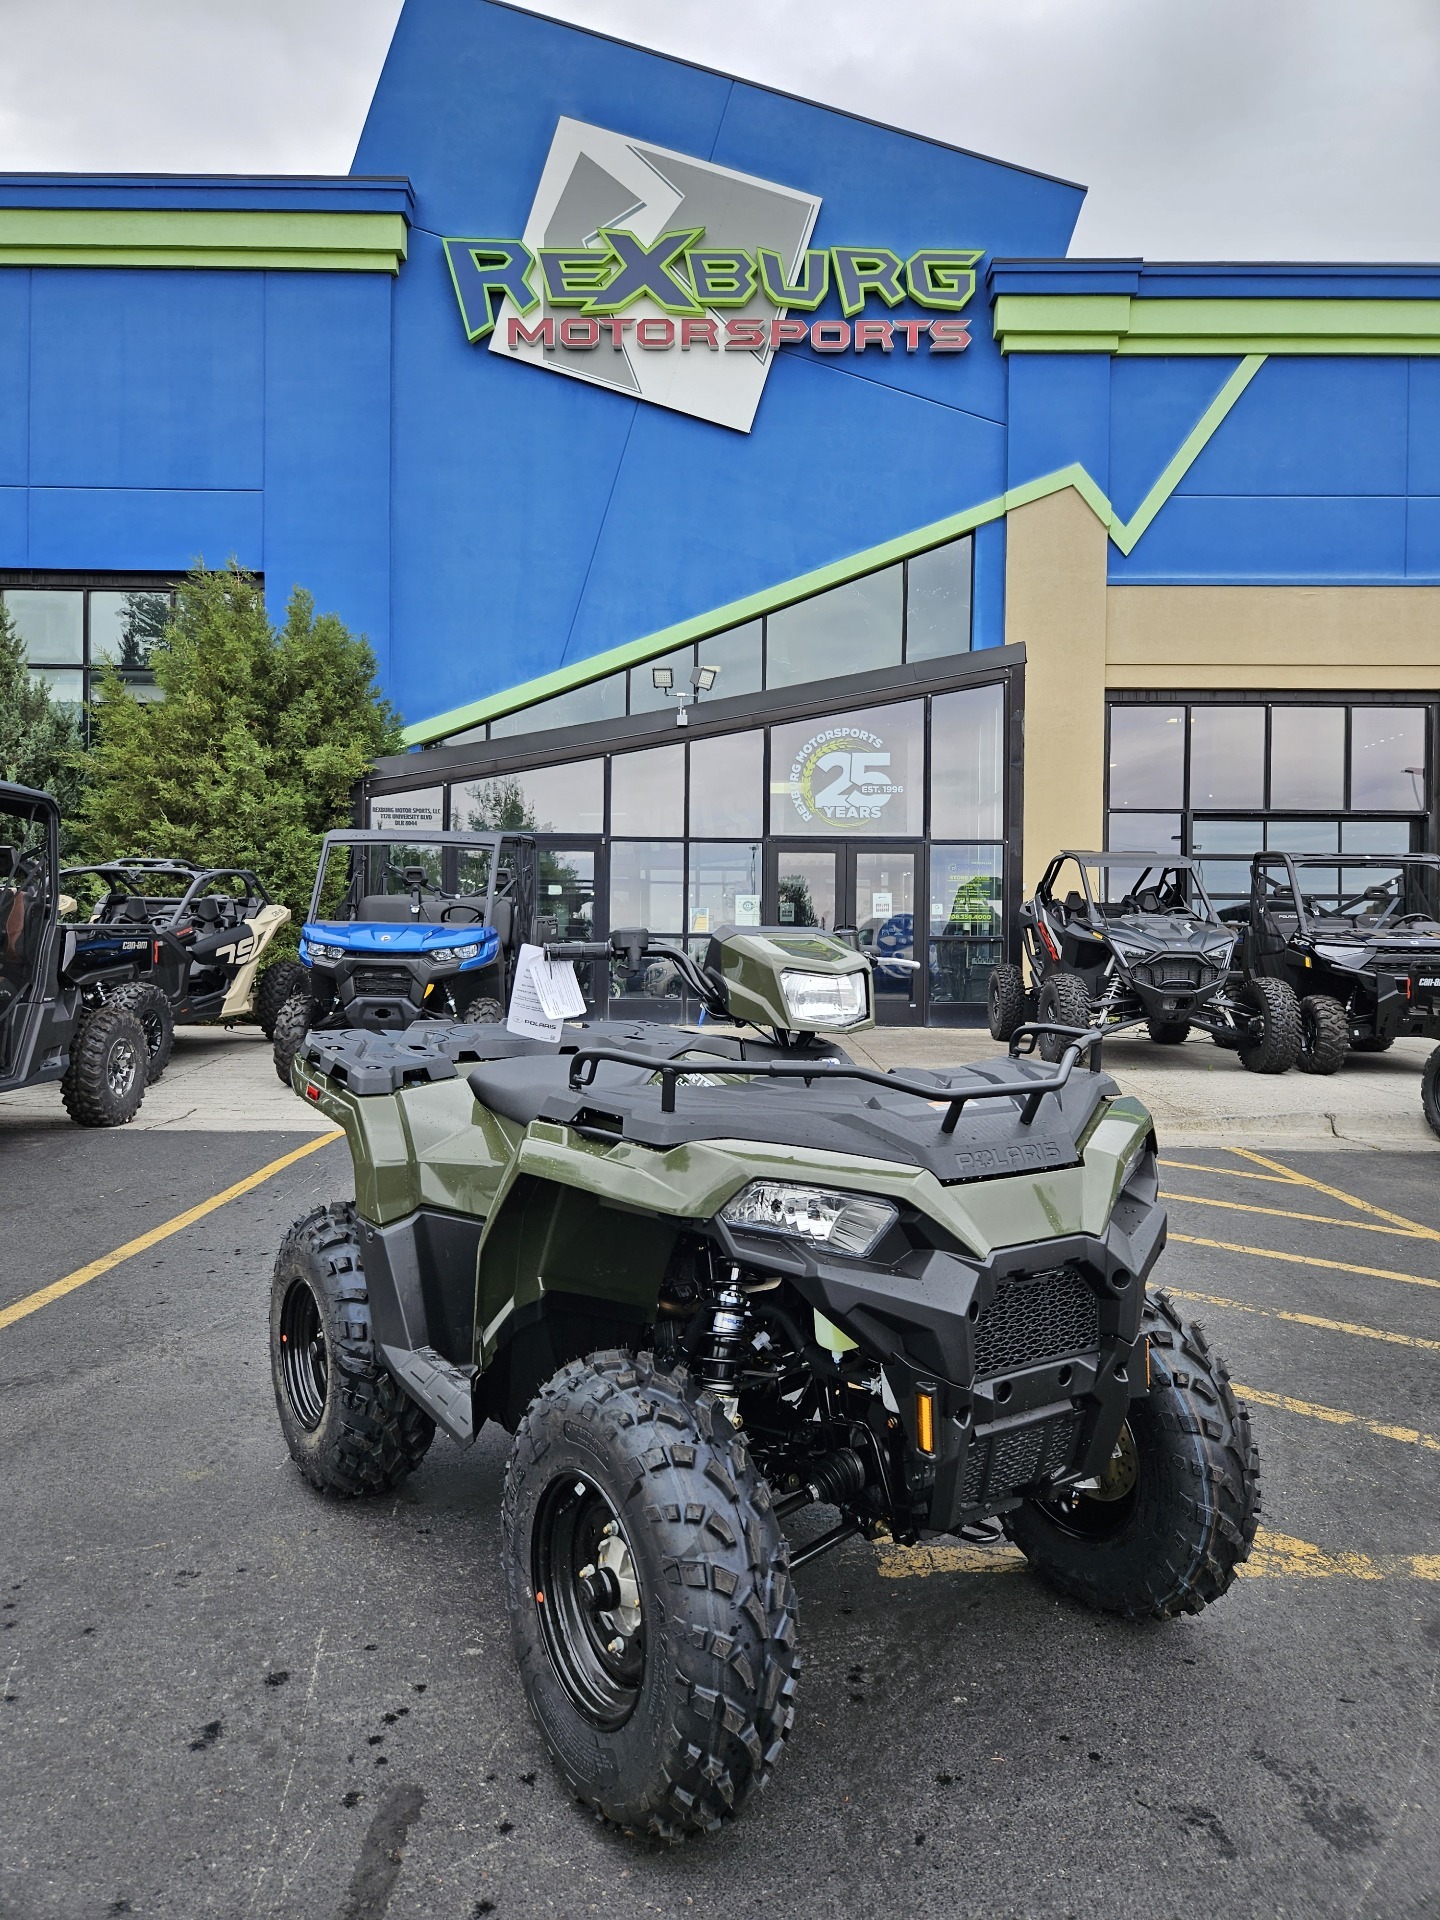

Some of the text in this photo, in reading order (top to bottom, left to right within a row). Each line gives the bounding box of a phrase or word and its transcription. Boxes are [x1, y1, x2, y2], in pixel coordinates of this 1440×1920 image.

[442, 226, 986, 343] REXBURG
[507, 317, 973, 353] MOTORSPORTS
[790, 728, 883, 822] REXBURG MOTORSPORTS
[815, 752, 891, 809] 25
[882, 785, 904, 793] 1996
[822, 806, 881, 818] YEARS
[524, 1019, 557, 1030] POLARIS
[954, 1141, 1061, 1171] POLARIS
